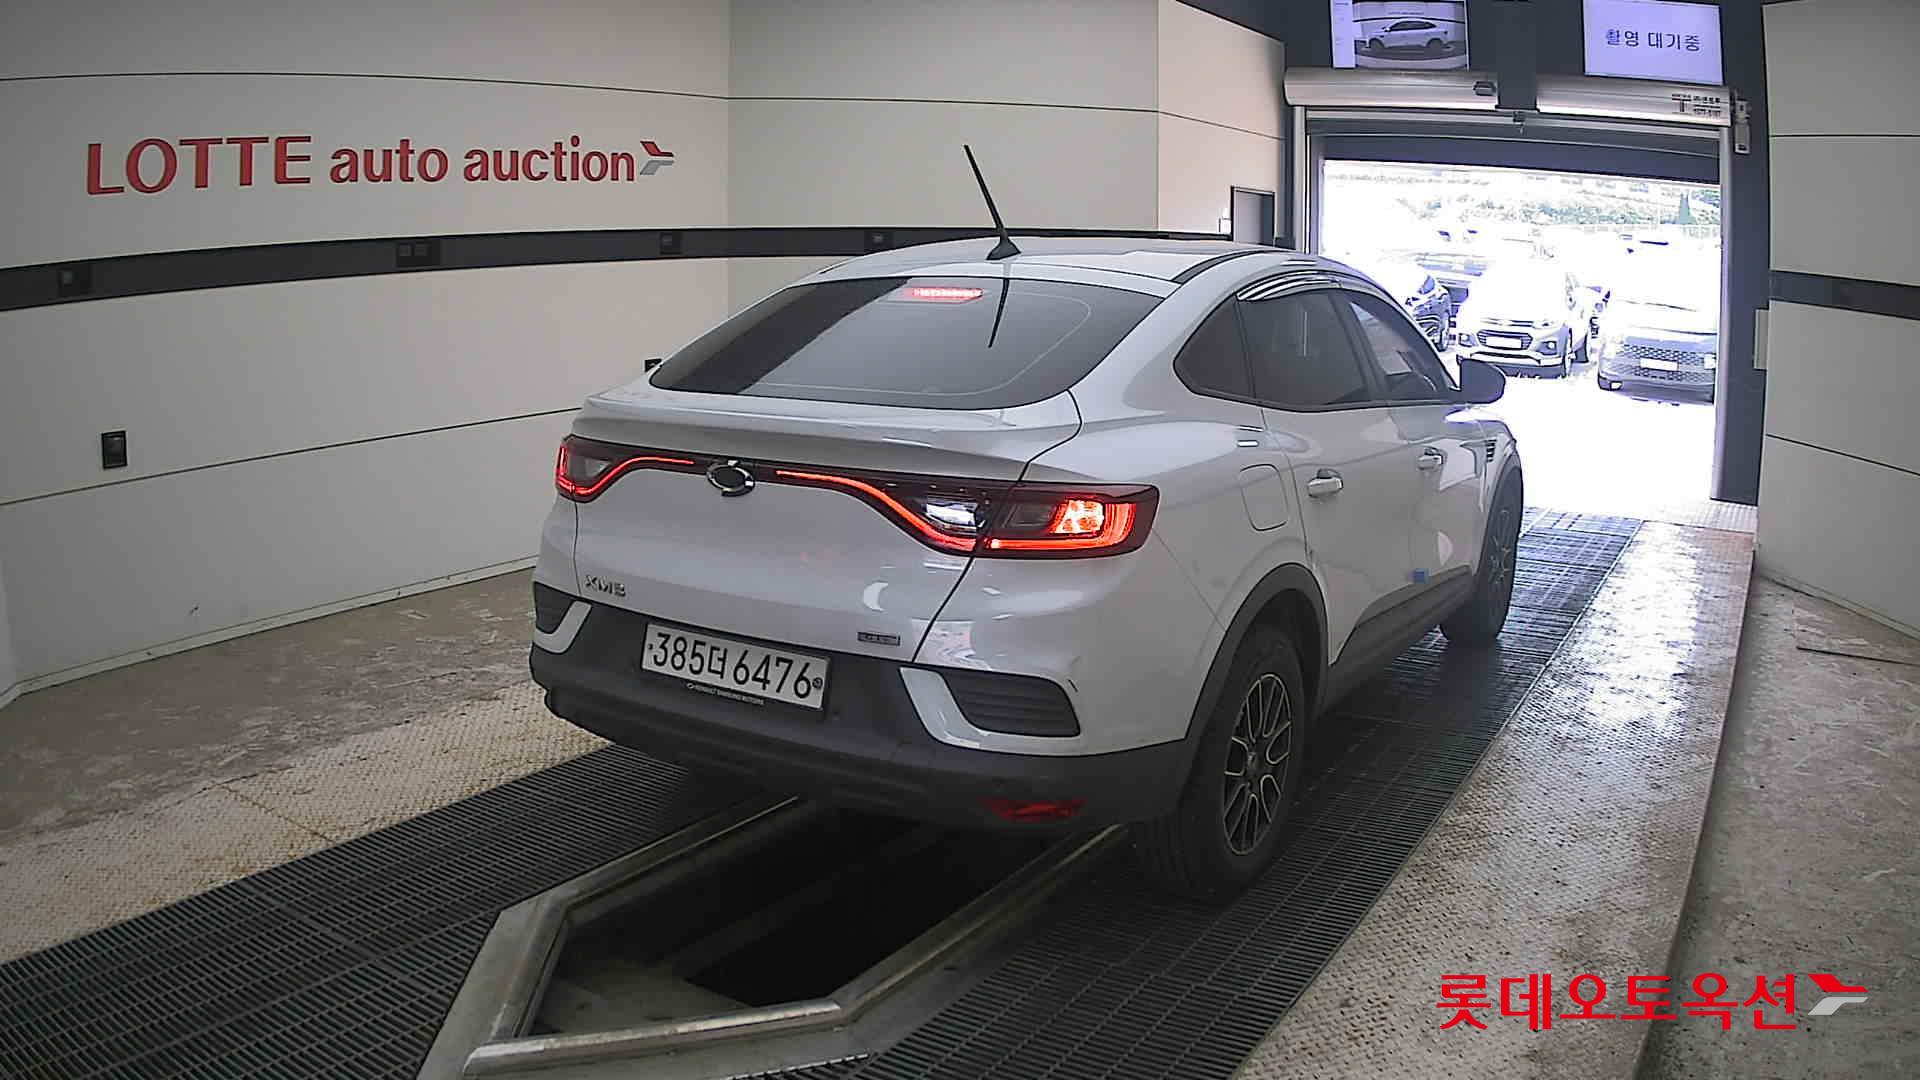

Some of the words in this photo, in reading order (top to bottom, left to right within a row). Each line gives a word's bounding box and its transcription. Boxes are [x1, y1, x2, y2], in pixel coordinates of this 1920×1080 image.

[1647, 31, 1701, 52] 대기중
[87, 135, 313, 196] LOTTE
[329, 139, 449, 184] auto
[463, 136, 636, 183] auction
